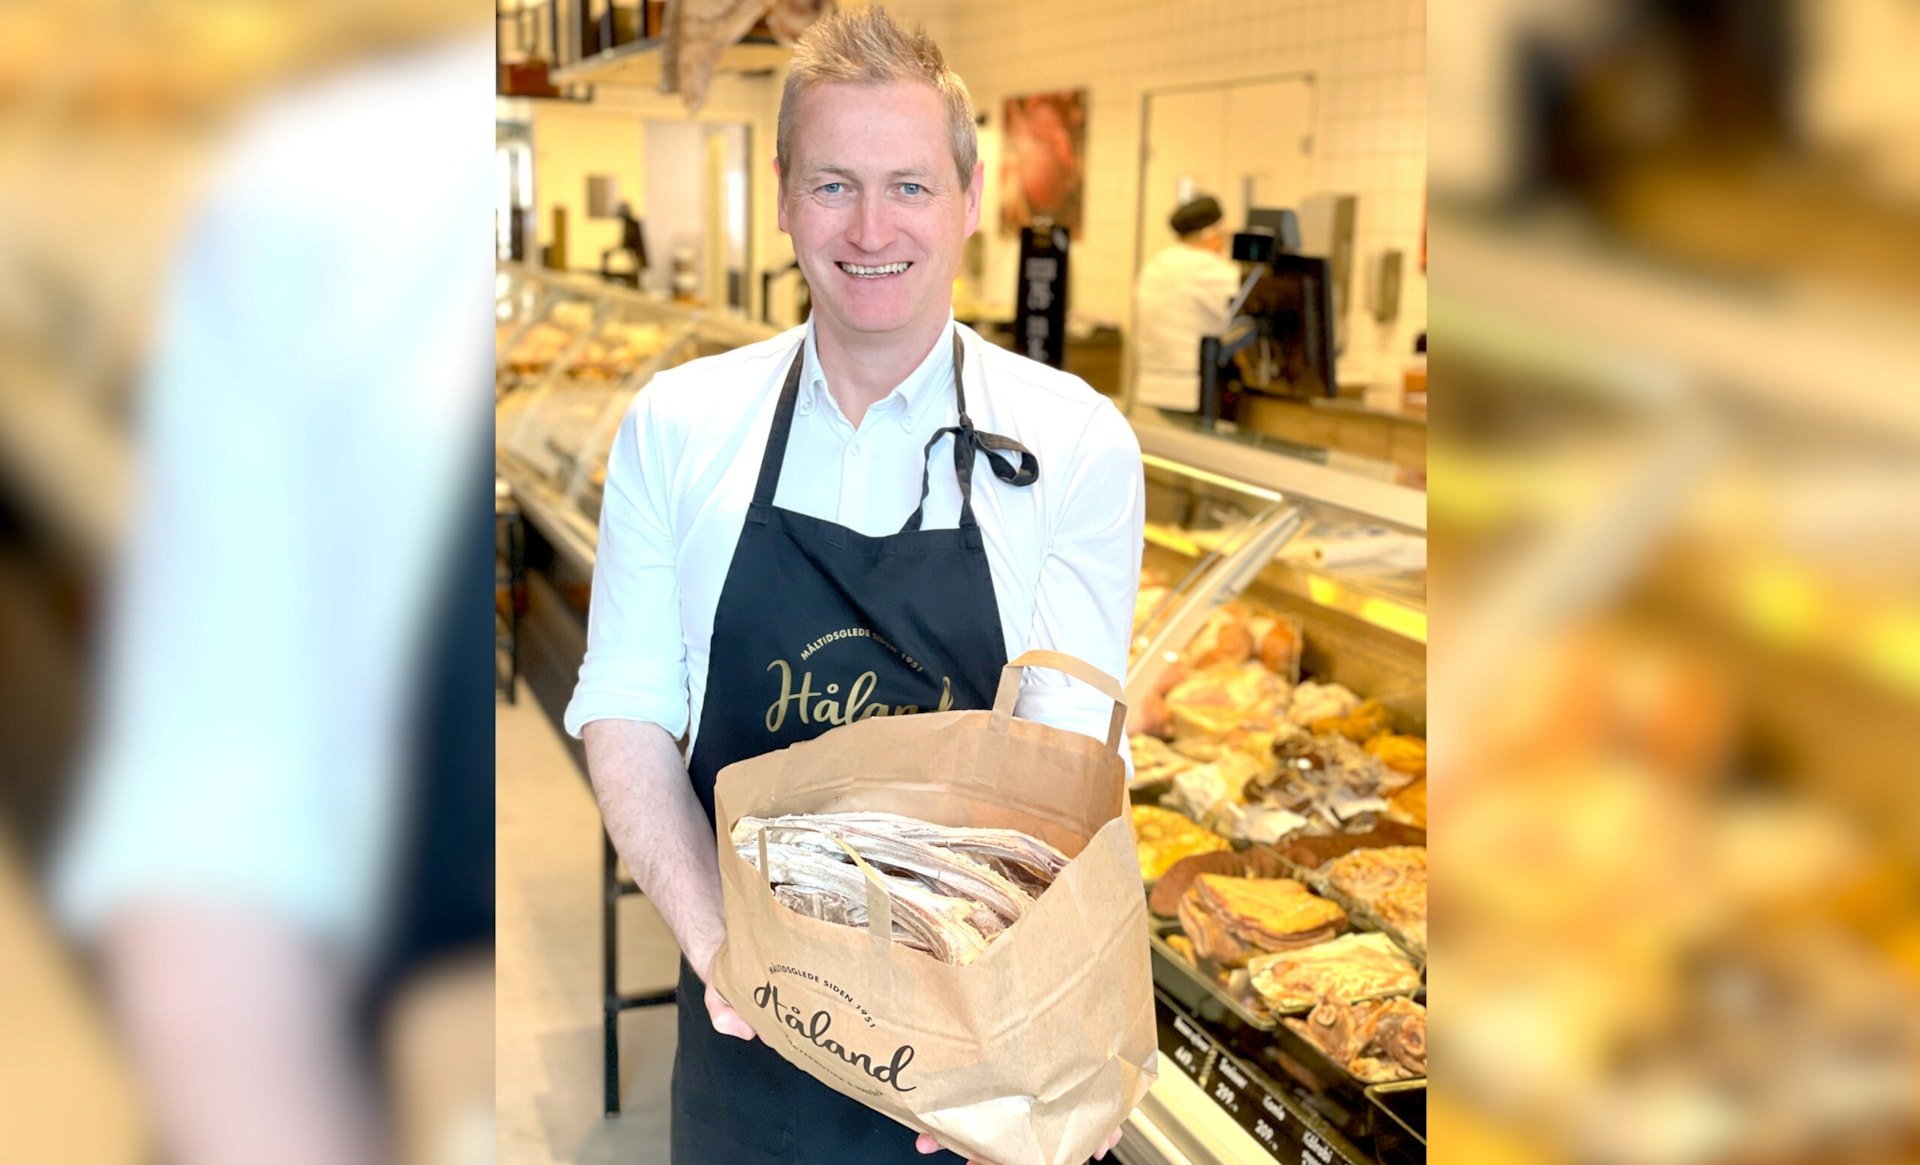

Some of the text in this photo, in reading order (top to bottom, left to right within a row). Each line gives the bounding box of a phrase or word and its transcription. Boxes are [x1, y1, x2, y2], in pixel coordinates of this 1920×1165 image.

[801, 627, 870, 660] MÅLTIDSGLEDE
[901, 652, 923, 672] 1951
[824, 980, 854, 1003] SIDEN
[856, 1004, 876, 1029] 1951
[754, 981, 916, 1092] Håland
